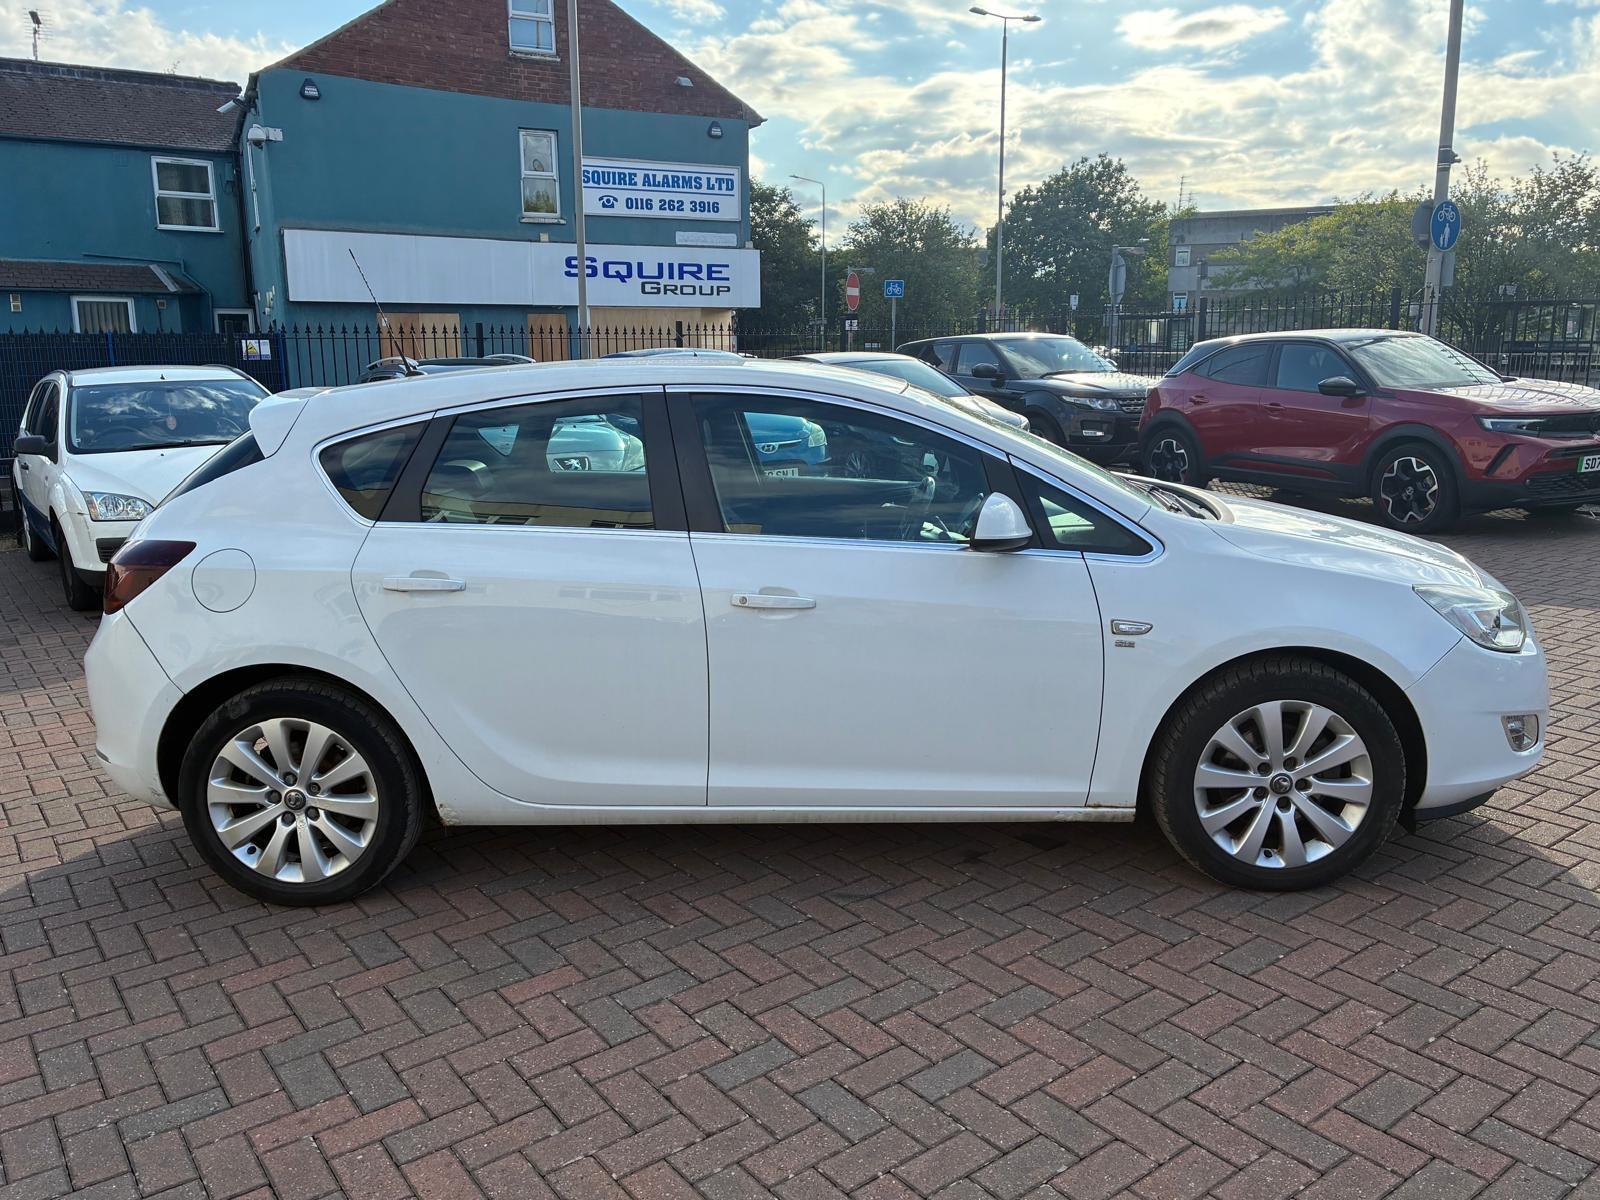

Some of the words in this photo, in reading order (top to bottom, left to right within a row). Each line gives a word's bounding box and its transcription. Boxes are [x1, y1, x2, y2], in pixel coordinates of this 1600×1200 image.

[583, 169, 638, 187] SQUIRE
[642, 173, 703, 190] ALARMS
[706, 176, 735, 192] LTD
[625, 197, 654, 211] 0116
[658, 200, 685, 212] 262
[689, 201, 720, 214] 3916
[564, 256, 730, 283] SQUIRE
[641, 281, 731, 296] GROUP
